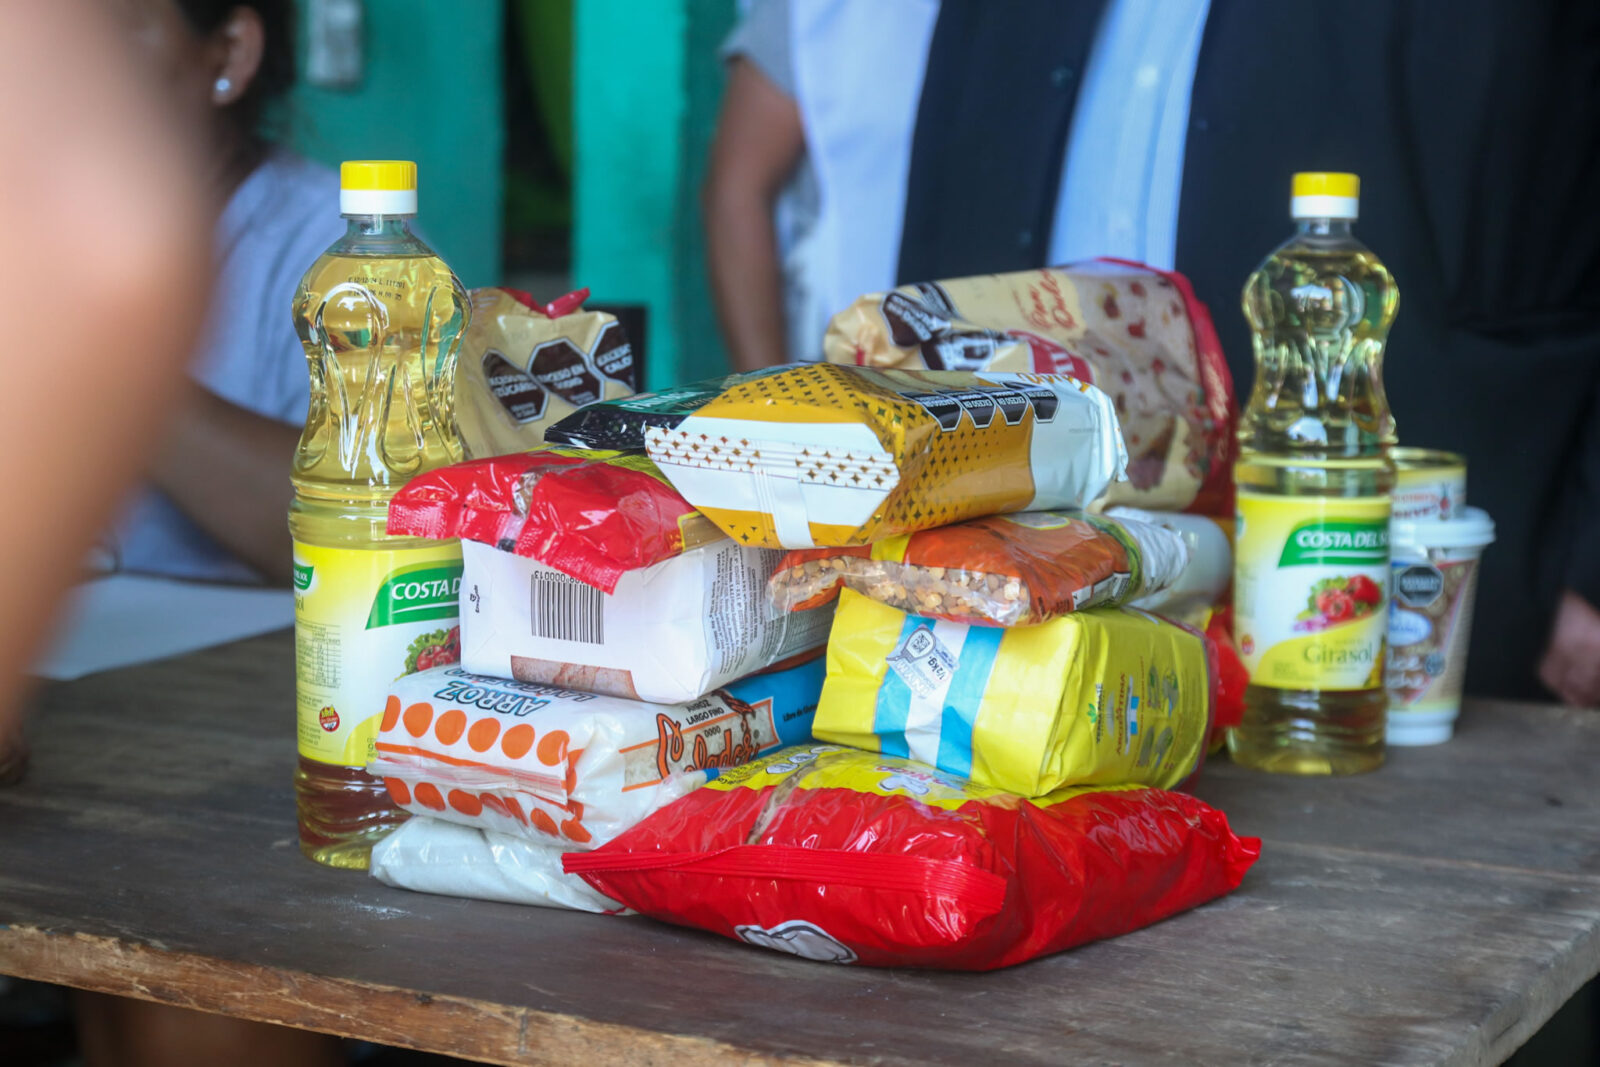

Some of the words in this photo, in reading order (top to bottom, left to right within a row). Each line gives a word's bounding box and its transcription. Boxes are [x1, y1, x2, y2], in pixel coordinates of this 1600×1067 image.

[1297, 530, 1351, 549] COSTA
[392, 579, 449, 600] COSTA
[1303, 642, 1373, 665] Girasol
[433, 679, 552, 717] ARROZ
[686, 712, 709, 725] LARGO
